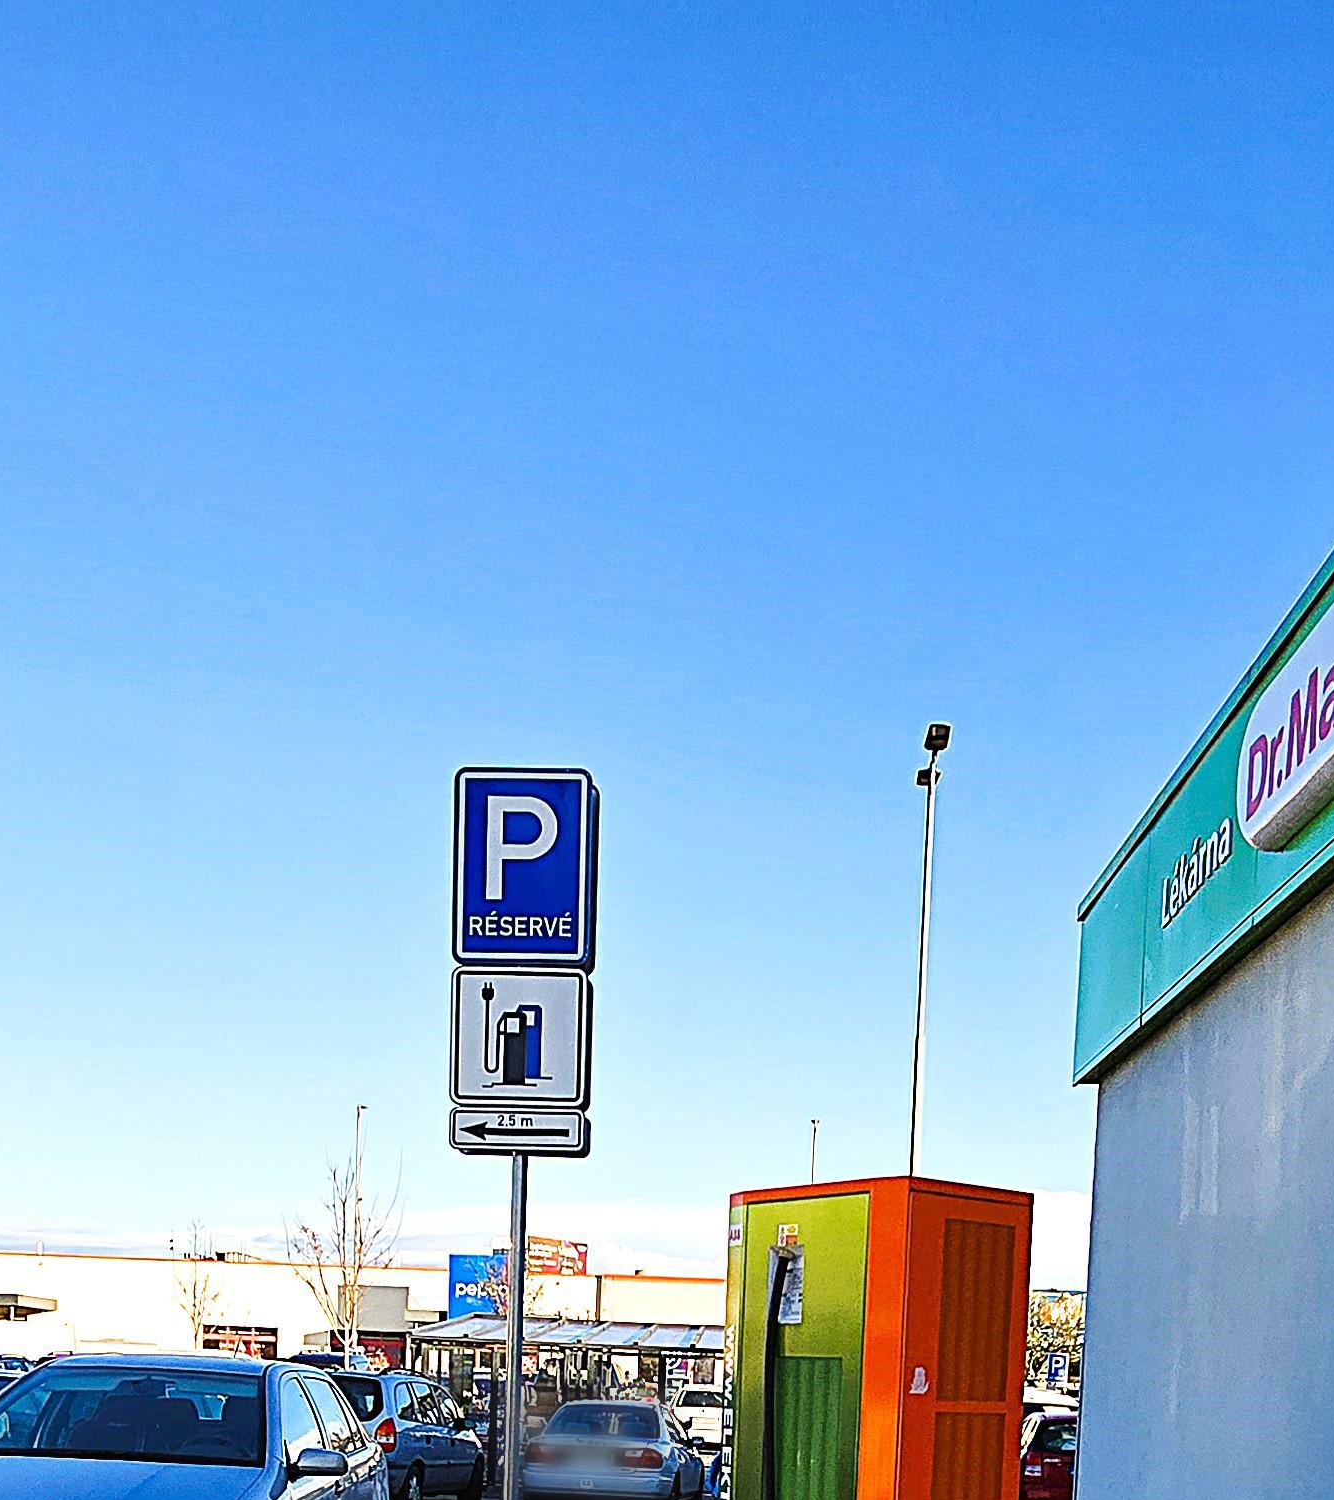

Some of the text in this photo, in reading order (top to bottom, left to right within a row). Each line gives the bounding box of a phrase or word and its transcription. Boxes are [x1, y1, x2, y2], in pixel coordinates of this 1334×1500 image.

[485, 795, 559, 901] P
[1160, 813, 1234, 930] Lékárna
[469, 911, 573, 938] RÉSERVÉ
[520, 1117, 534, 1128] m
[455, 1282, 510, 1299] pepco
[1052, 1357, 1064, 1374] P
